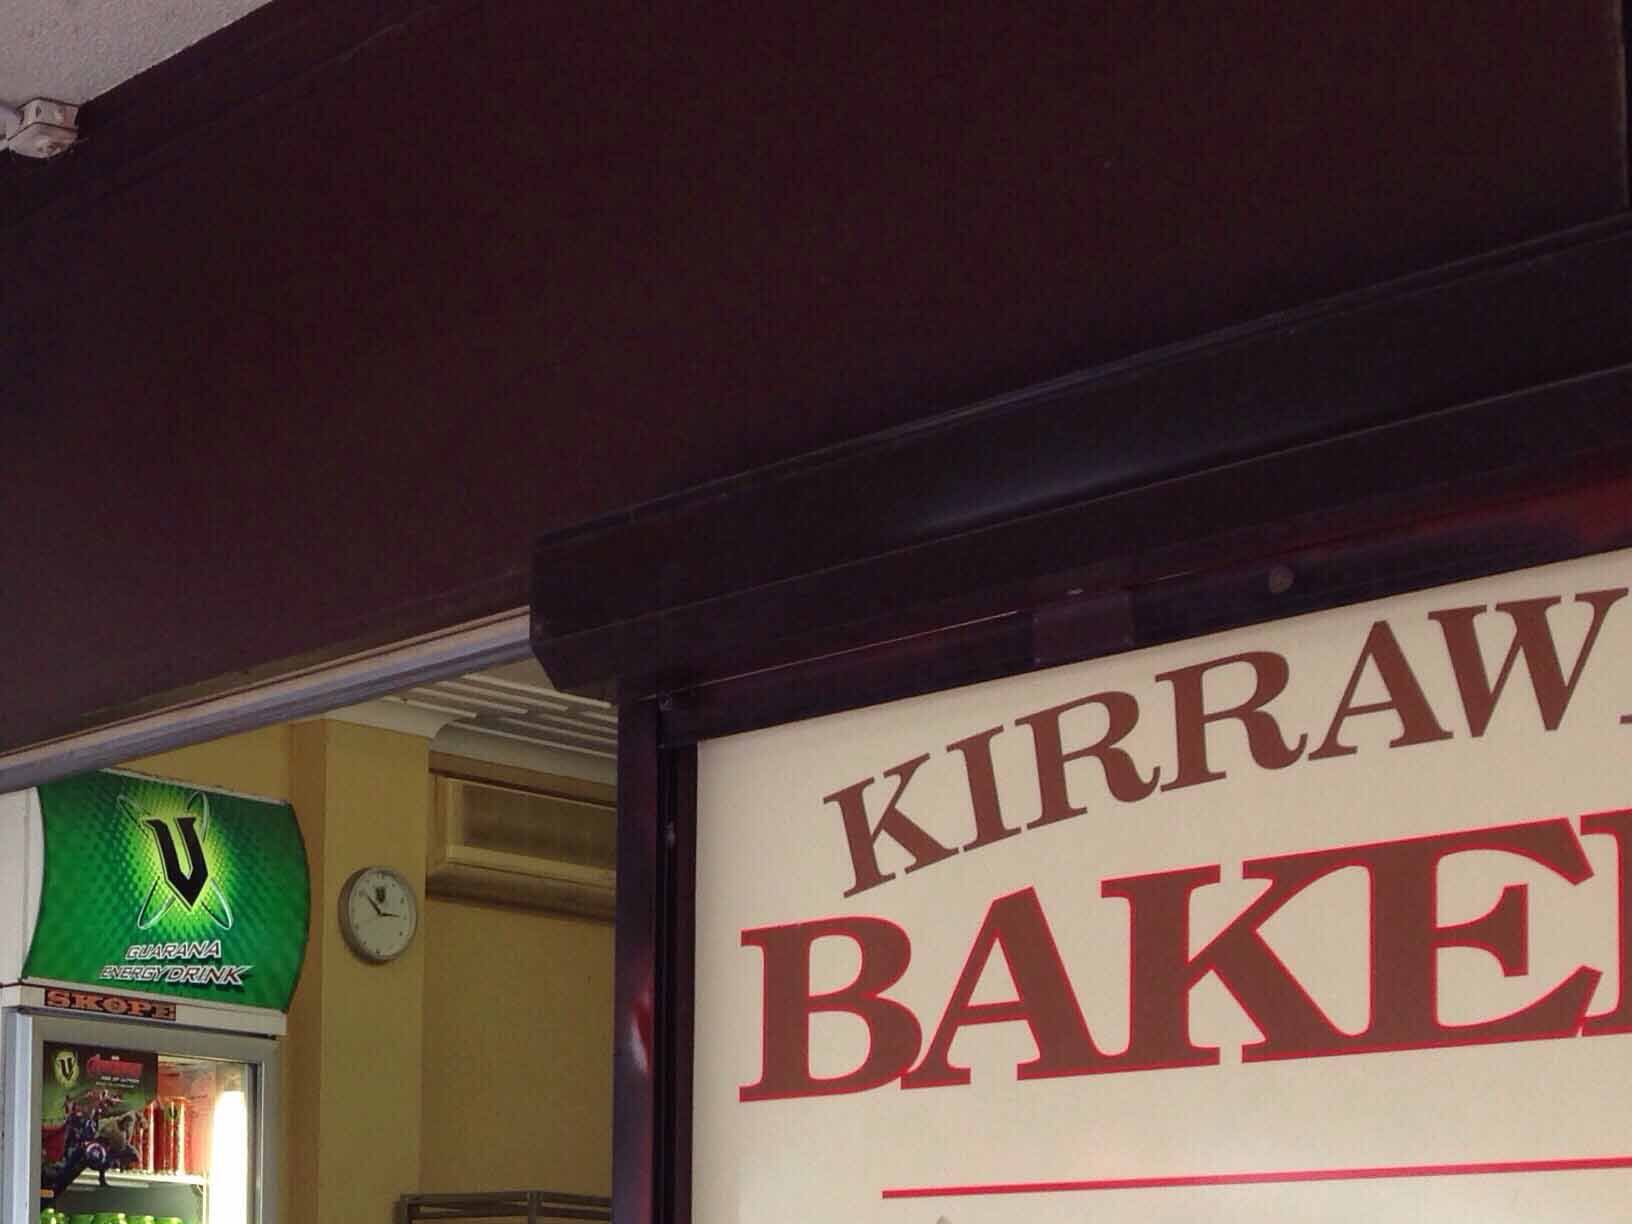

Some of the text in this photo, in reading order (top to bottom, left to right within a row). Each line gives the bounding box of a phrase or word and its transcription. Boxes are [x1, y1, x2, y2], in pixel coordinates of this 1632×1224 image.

[823, 586, 1632, 898] KIRRAW
[141, 816, 208, 912] V
[125, 939, 221, 960] GUARANA
[99, 965, 255, 985] ENERGY DRINK
[46, 988, 176, 1021] SKOPE
